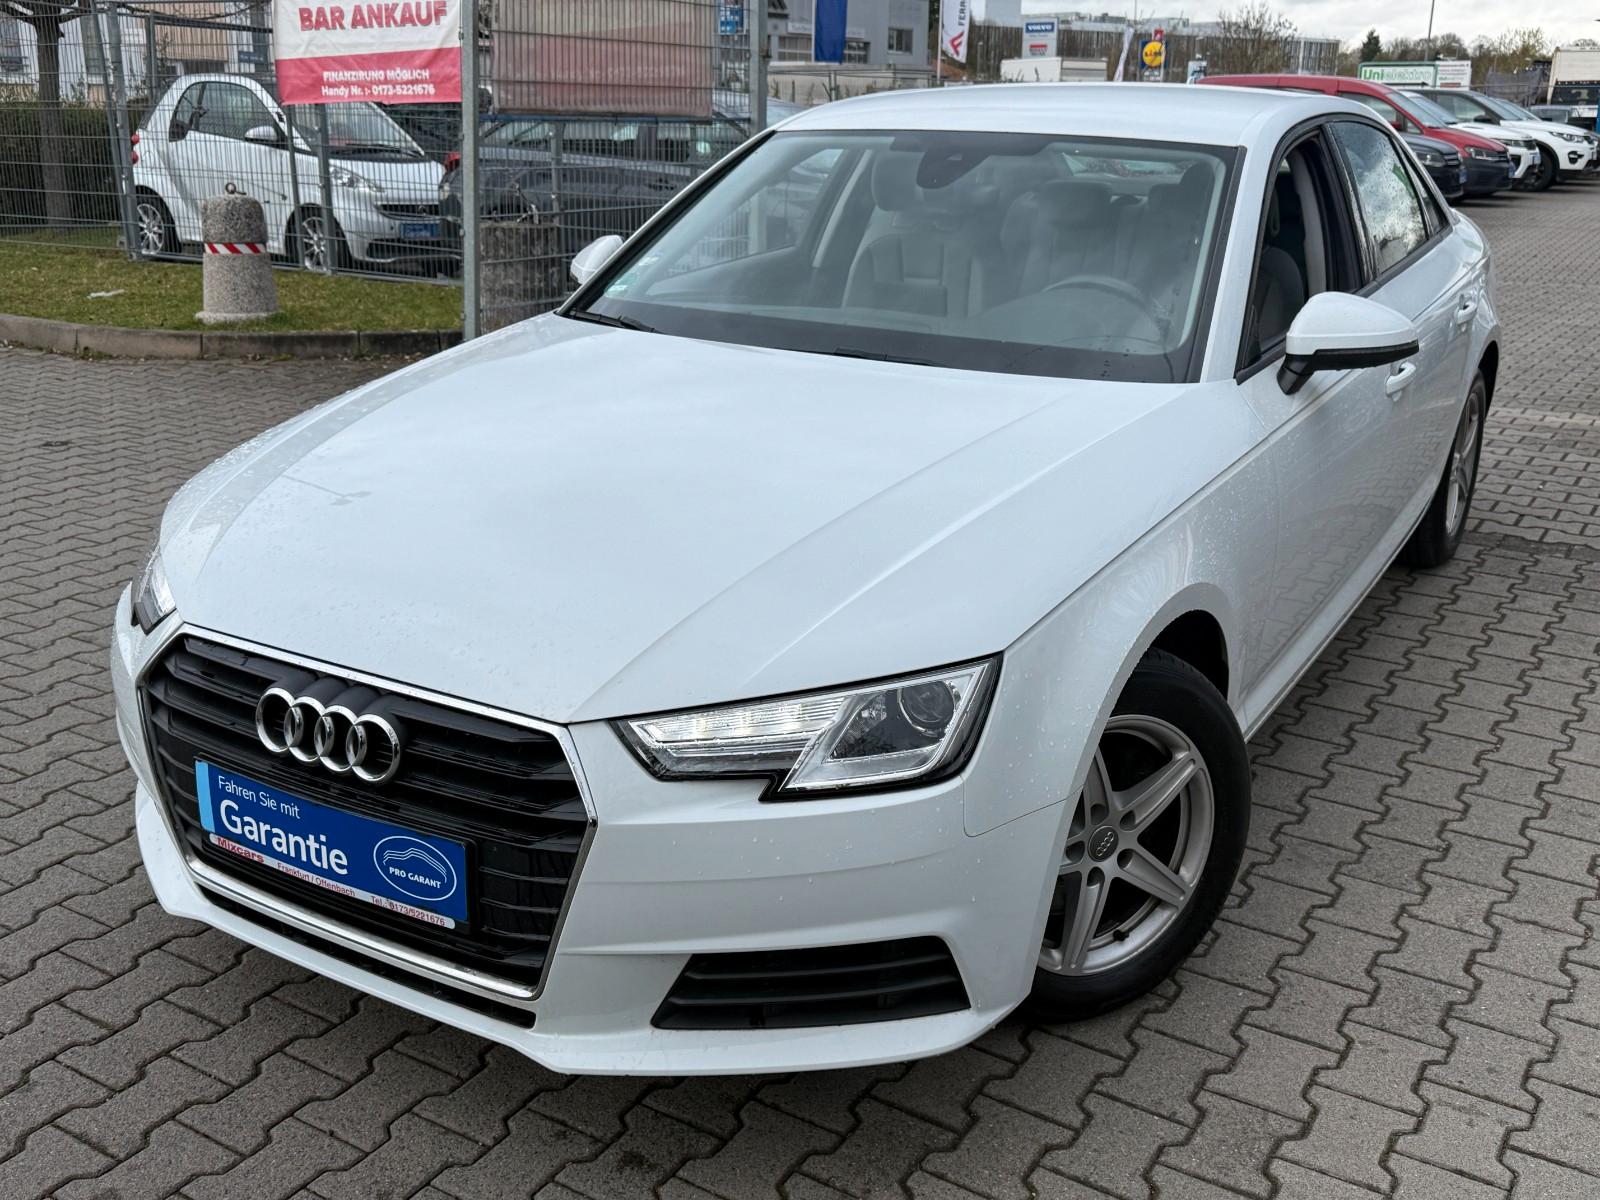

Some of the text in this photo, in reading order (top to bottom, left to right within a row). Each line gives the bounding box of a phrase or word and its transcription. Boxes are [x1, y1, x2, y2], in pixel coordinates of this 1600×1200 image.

[299, 1, 447, 31] BAR ANKAUF
[386, 67, 430, 81] MÖGLICH
[321, 85, 349, 98] Handy
[372, 84, 435, 95] 0173-5221676
[218, 775, 301, 819] Fahren Sie mit
[220, 799, 348, 875] Garantie
[217, 837, 265, 863] Mixcars
[316, 878, 355, 897] Offenbach
[389, 900, 445, 927] 0173/5221676
[389, 867, 442, 889] PRO GARANT
